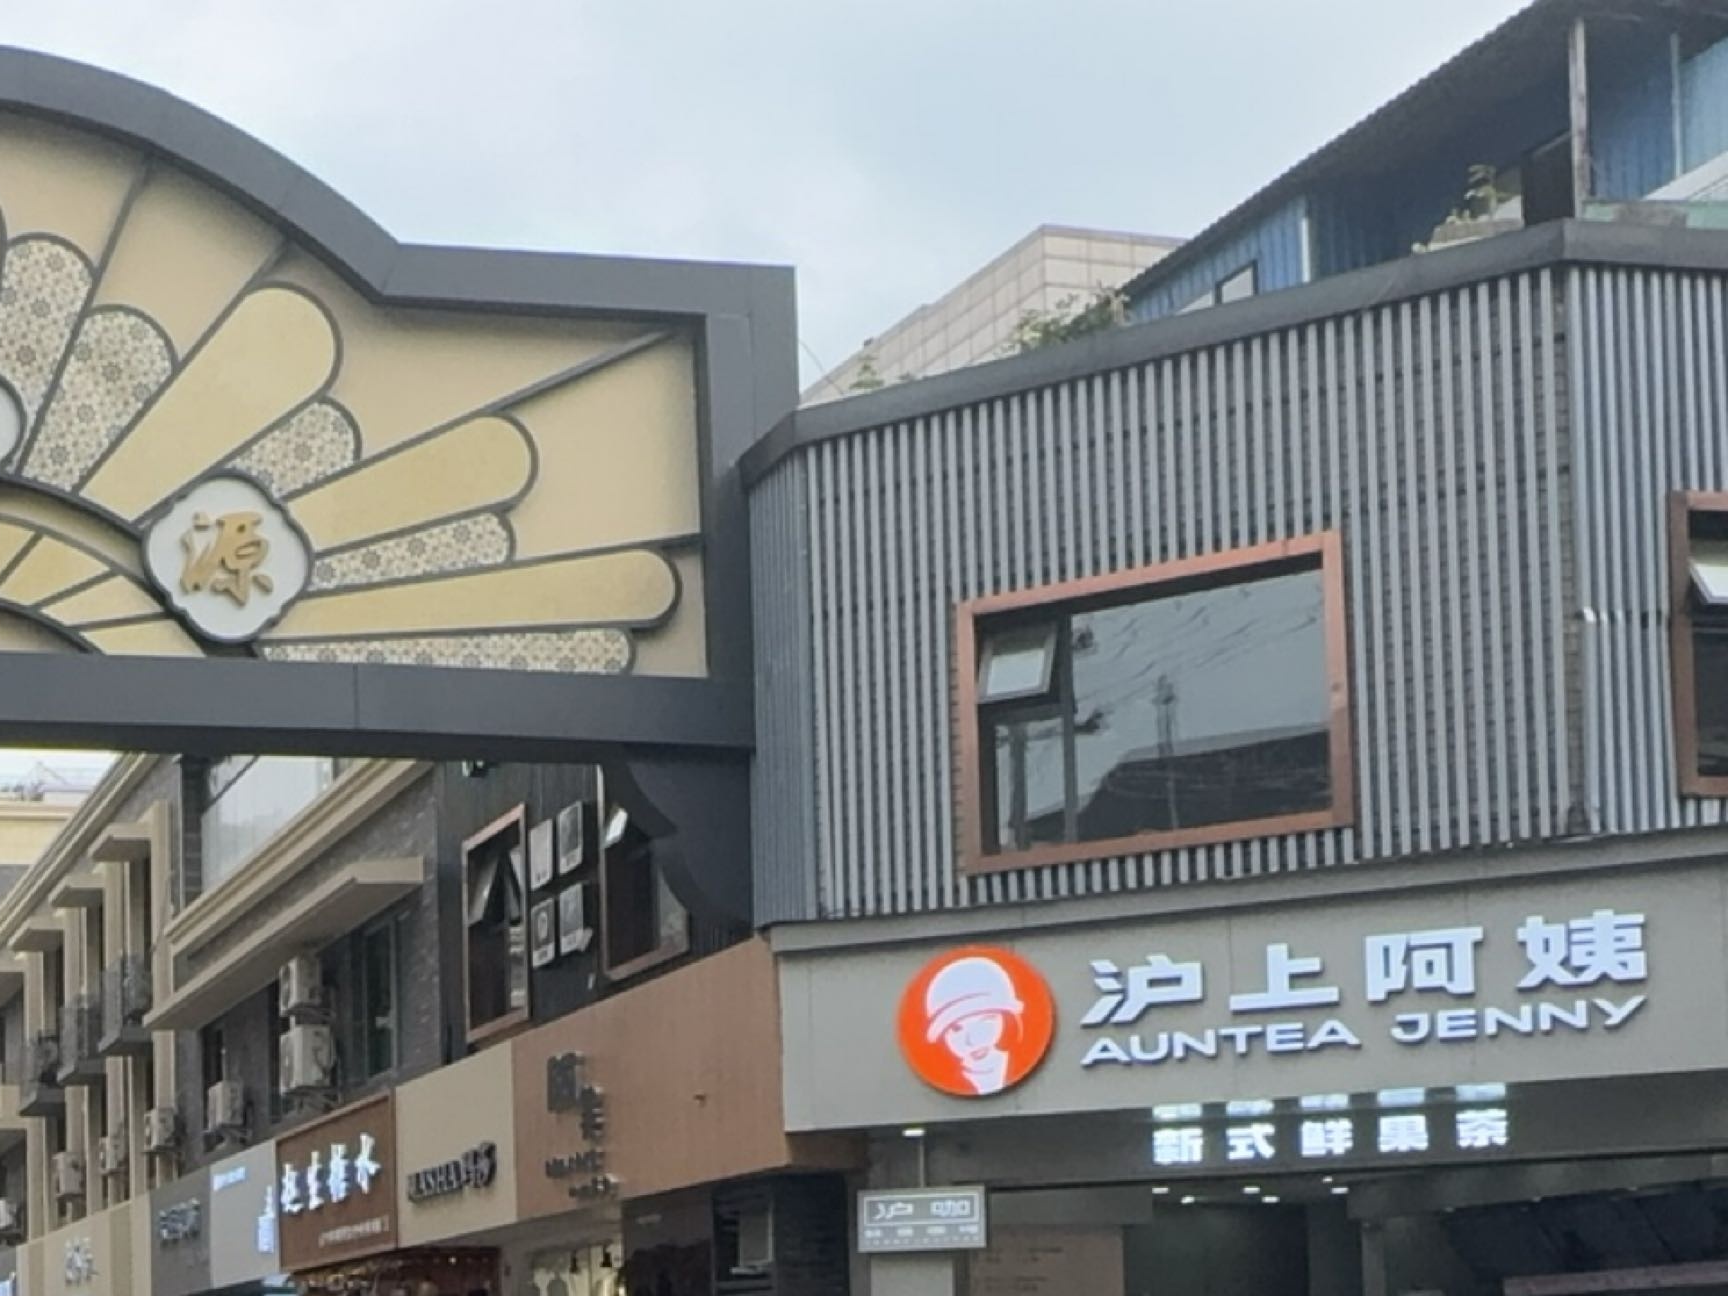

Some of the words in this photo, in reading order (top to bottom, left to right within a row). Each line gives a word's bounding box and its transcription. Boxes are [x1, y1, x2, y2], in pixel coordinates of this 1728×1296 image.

[1080, 908, 1648, 1026] 沪上阿姨
[1080, 1020, 1362, 1068] AUNTEA
[1390, 996, 1648, 1044] JENNY
